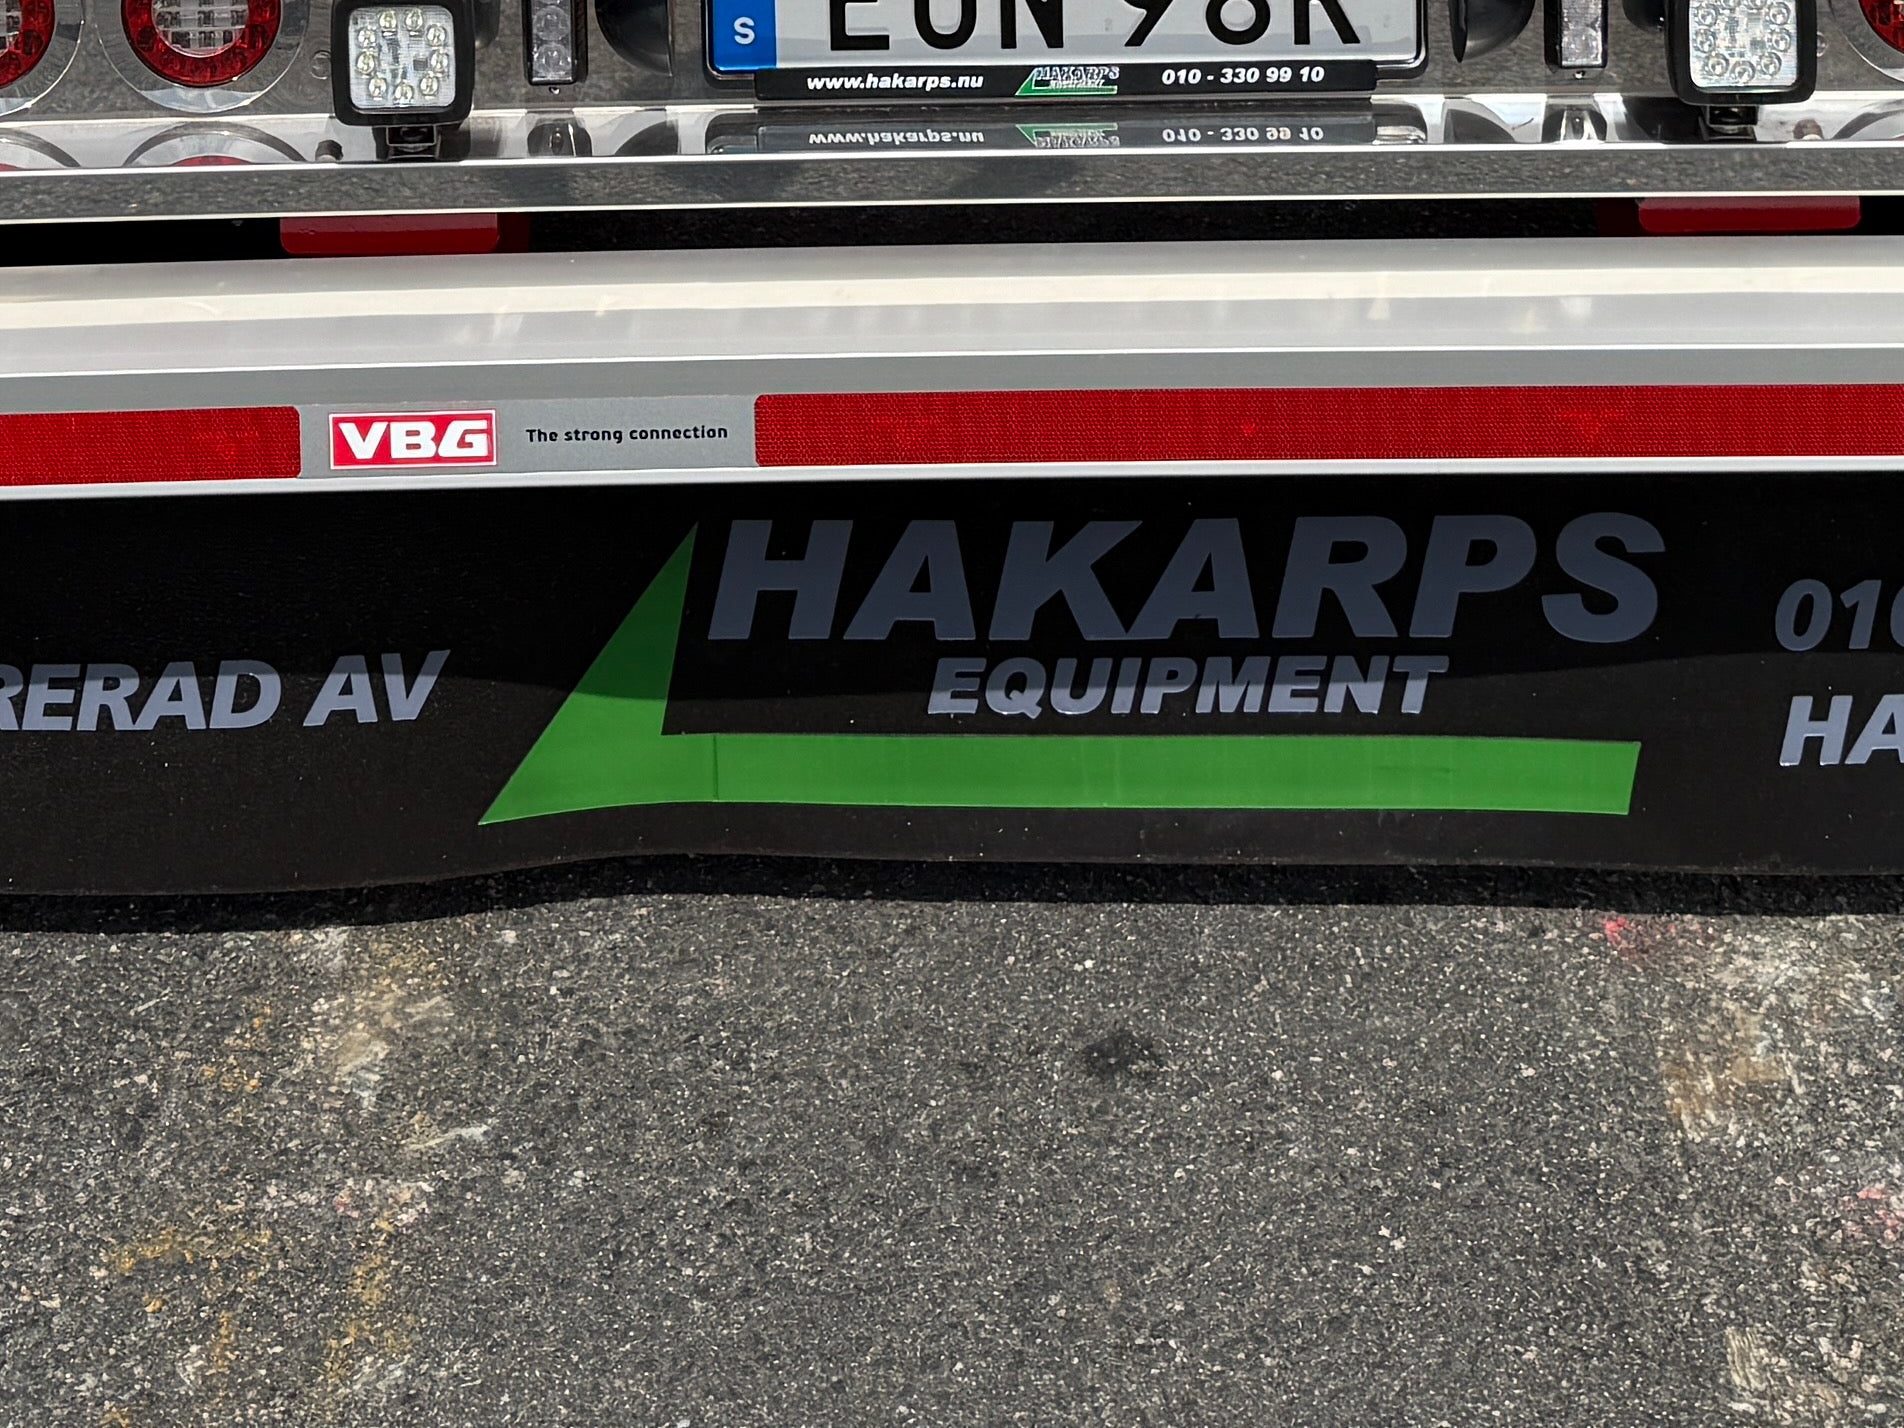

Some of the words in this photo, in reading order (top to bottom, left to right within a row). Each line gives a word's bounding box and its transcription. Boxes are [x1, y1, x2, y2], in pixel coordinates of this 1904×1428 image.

[733, 16, 755, 45] S
[807, 72, 984, 92] www.hakarps.nu
[1161, 69, 1202, 85] 010
[1219, 67, 1260, 84] 330
[1266, 66, 1293, 83] 99
[1299, 66, 1325, 82] 10
[338, 419, 488, 460] VBG
[525, 428, 559, 443] The
[564, 427, 623, 444] strong
[629, 425, 728, 440] connection
[707, 512, 1666, 644] HAKARPS
[302, 649, 452, 727] AV
[926, 655, 1449, 720] EQUIPMENT
